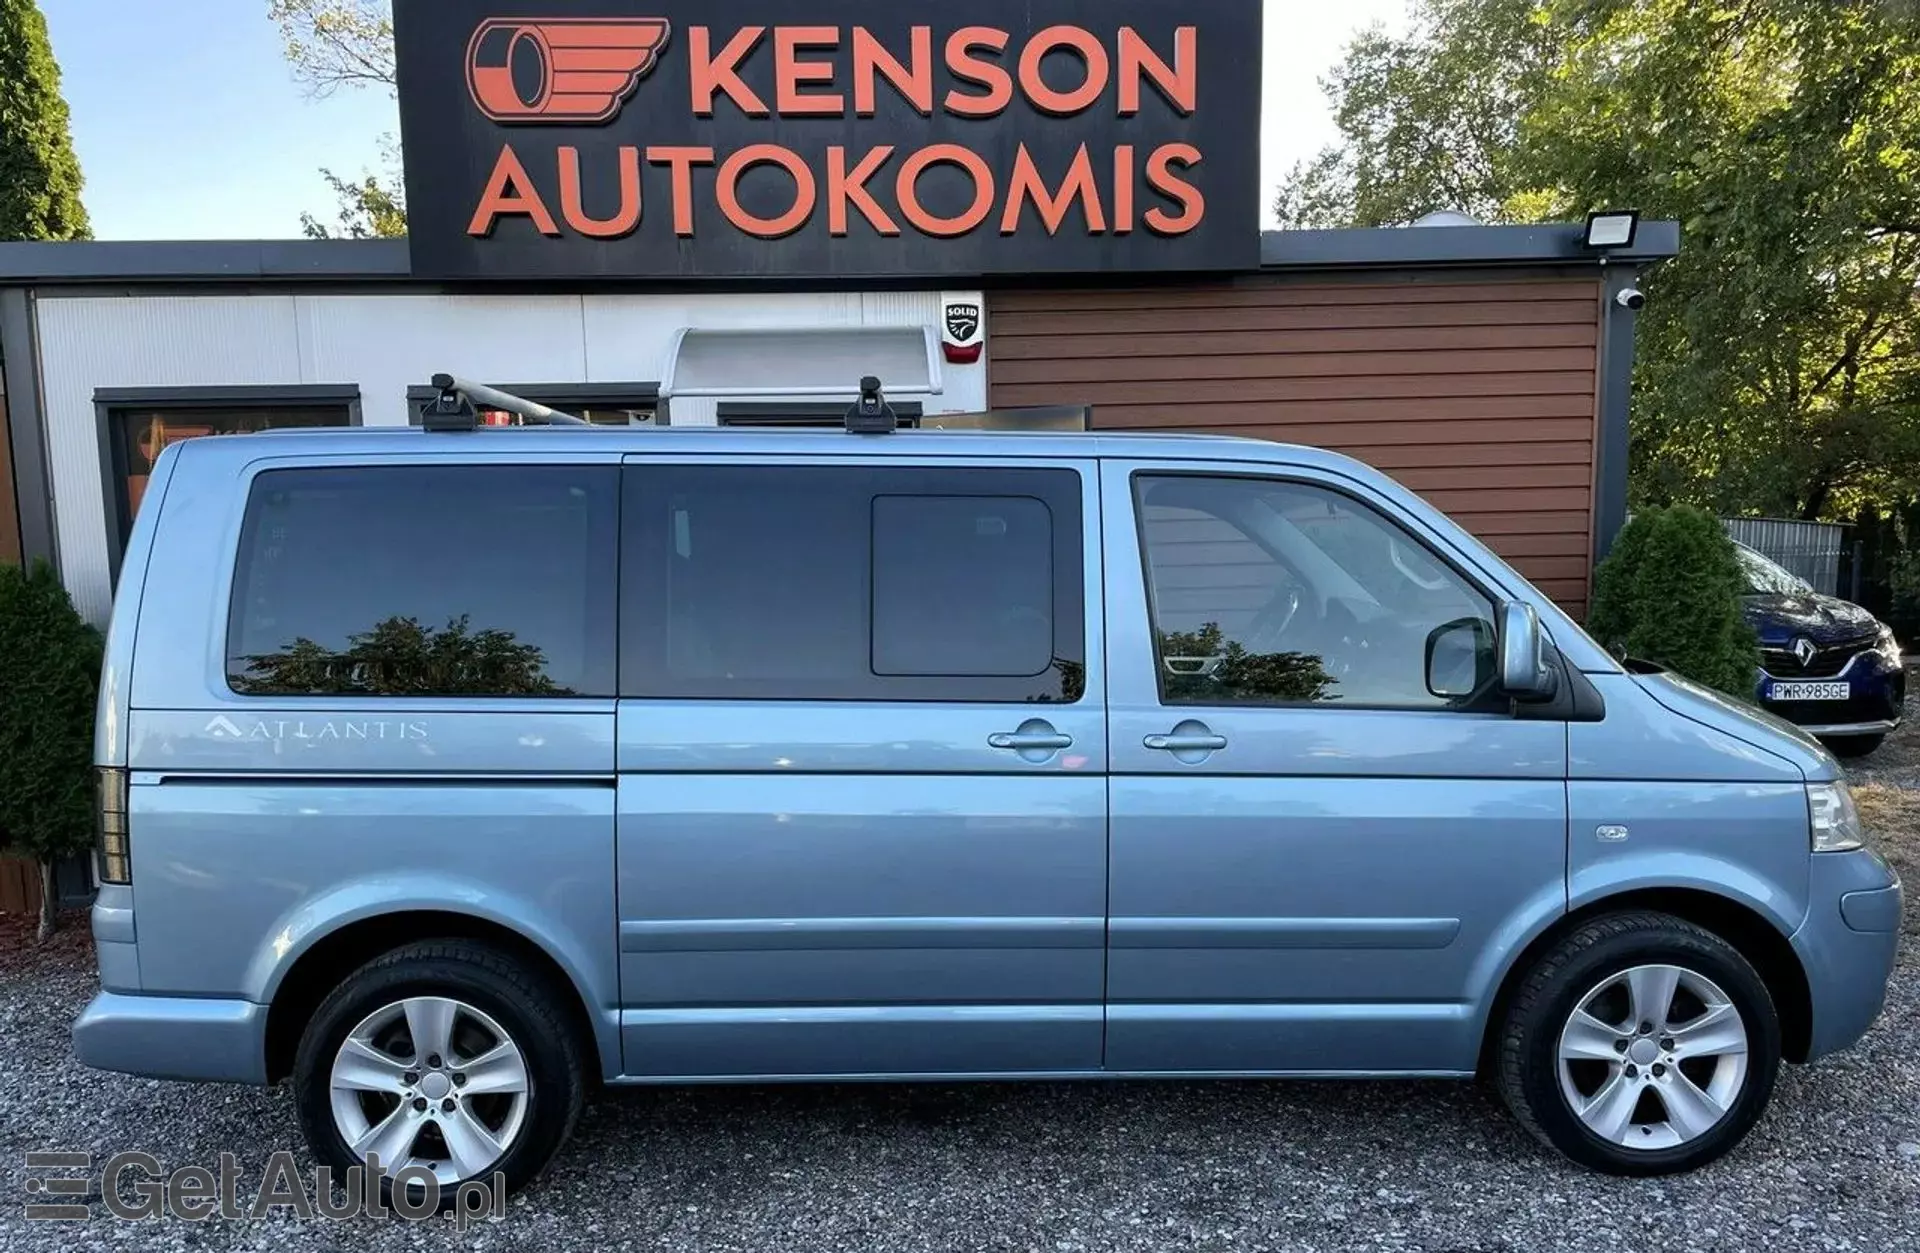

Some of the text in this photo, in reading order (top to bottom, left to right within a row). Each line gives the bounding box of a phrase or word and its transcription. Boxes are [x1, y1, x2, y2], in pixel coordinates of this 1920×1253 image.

[688, 25, 1197, 116] KENSON
[466, 142, 1205, 237] AUTOKOMIS
[948, 307, 977, 316] SOLID
[1774, 684, 1801, 698] PWR
[1805, 684, 1848, 698] 985GE
[250, 721, 429, 739] ATLANTIS
